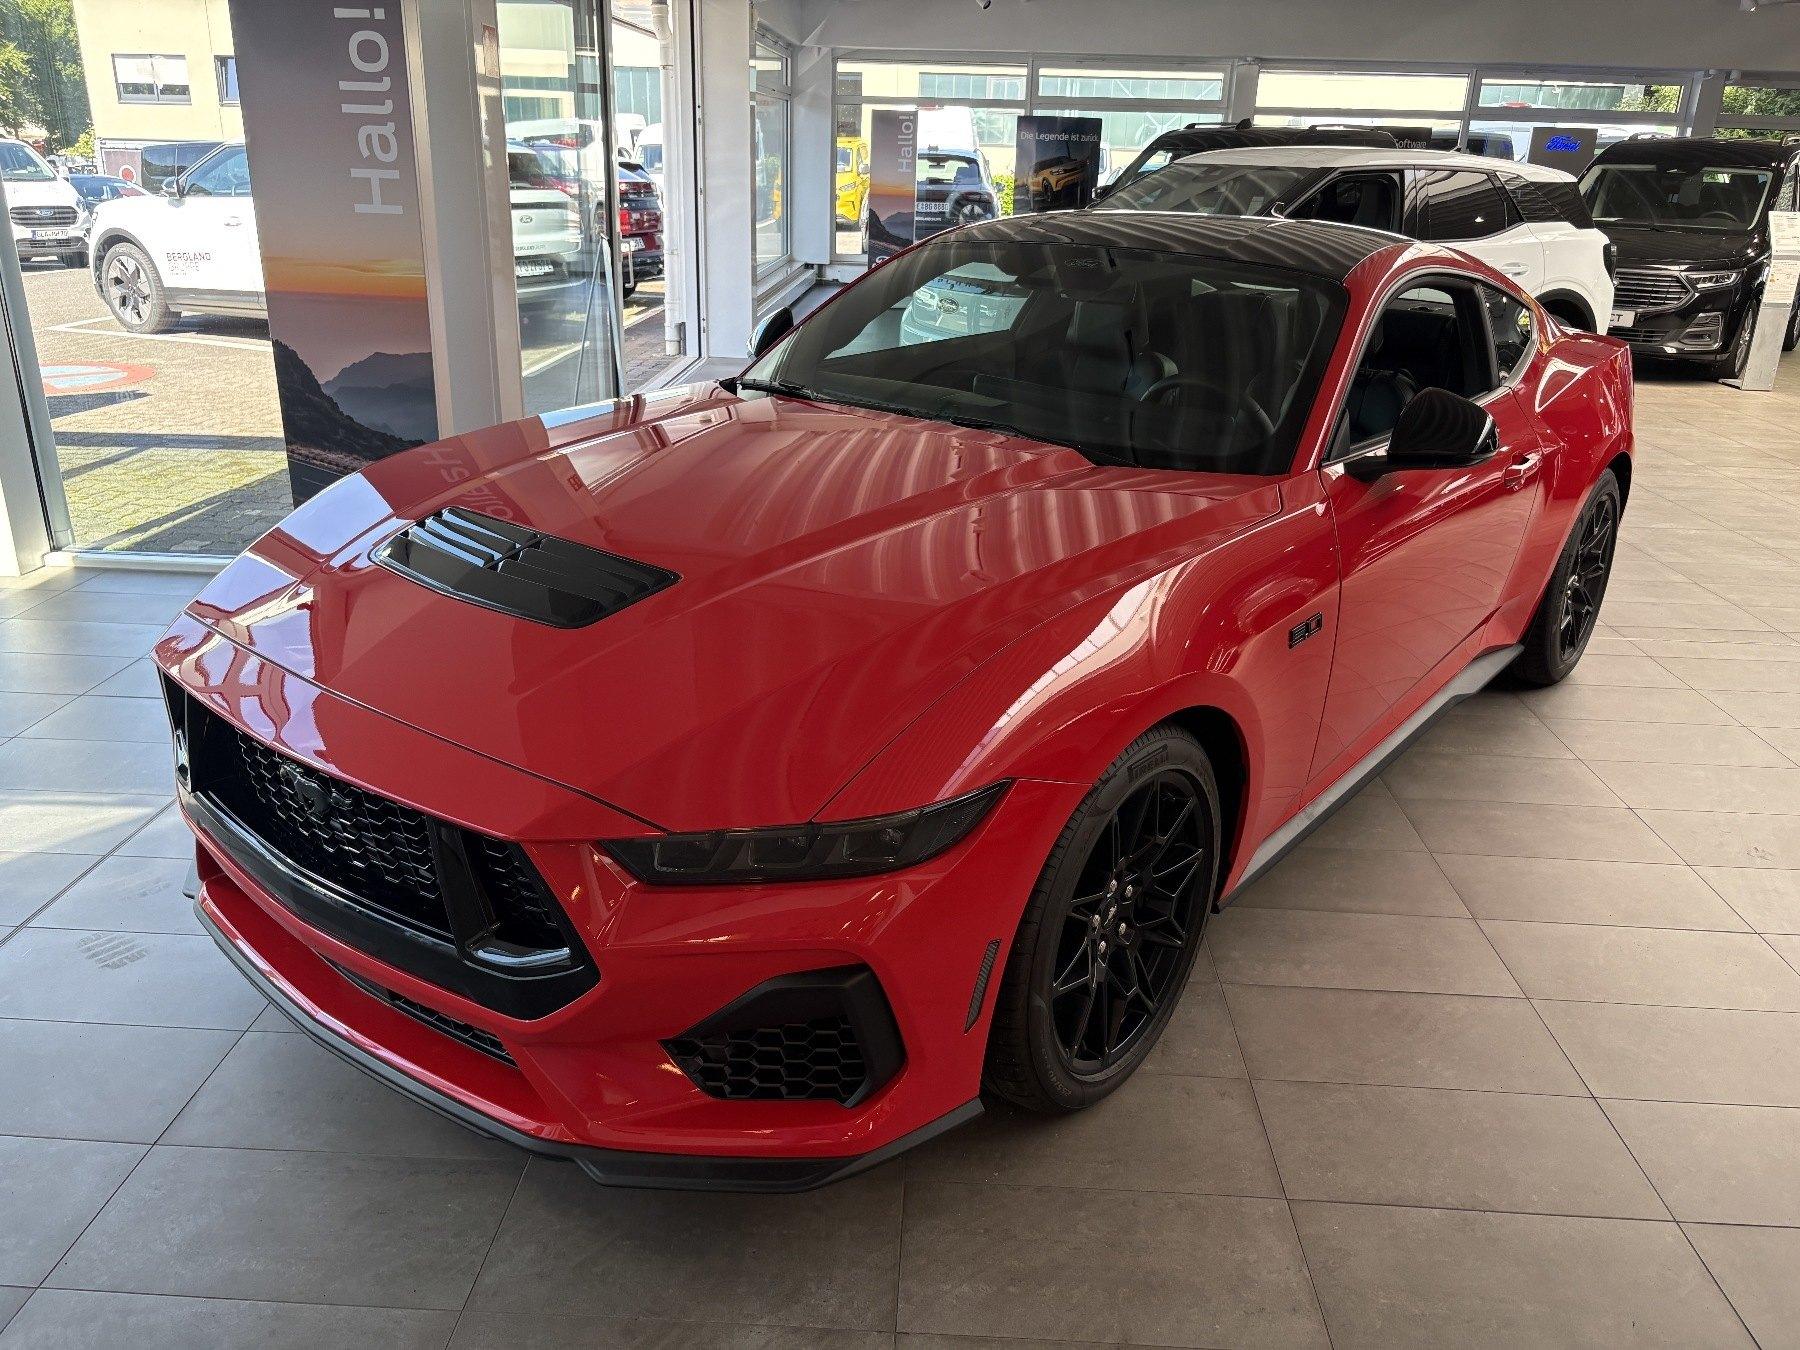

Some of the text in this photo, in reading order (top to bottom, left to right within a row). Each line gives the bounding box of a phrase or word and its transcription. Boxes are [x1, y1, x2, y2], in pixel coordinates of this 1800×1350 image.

[333, 7, 403, 214] Hallo!
[898, 115, 914, 173] Hallo!
[1020, 131, 1034, 140] Die
[1035, 131, 1069, 142] Legende
[1071, 132, 1080, 142] ist
[1545, 135, 1582, 152] Ford
[166, 252, 211, 262] BERGLAND
